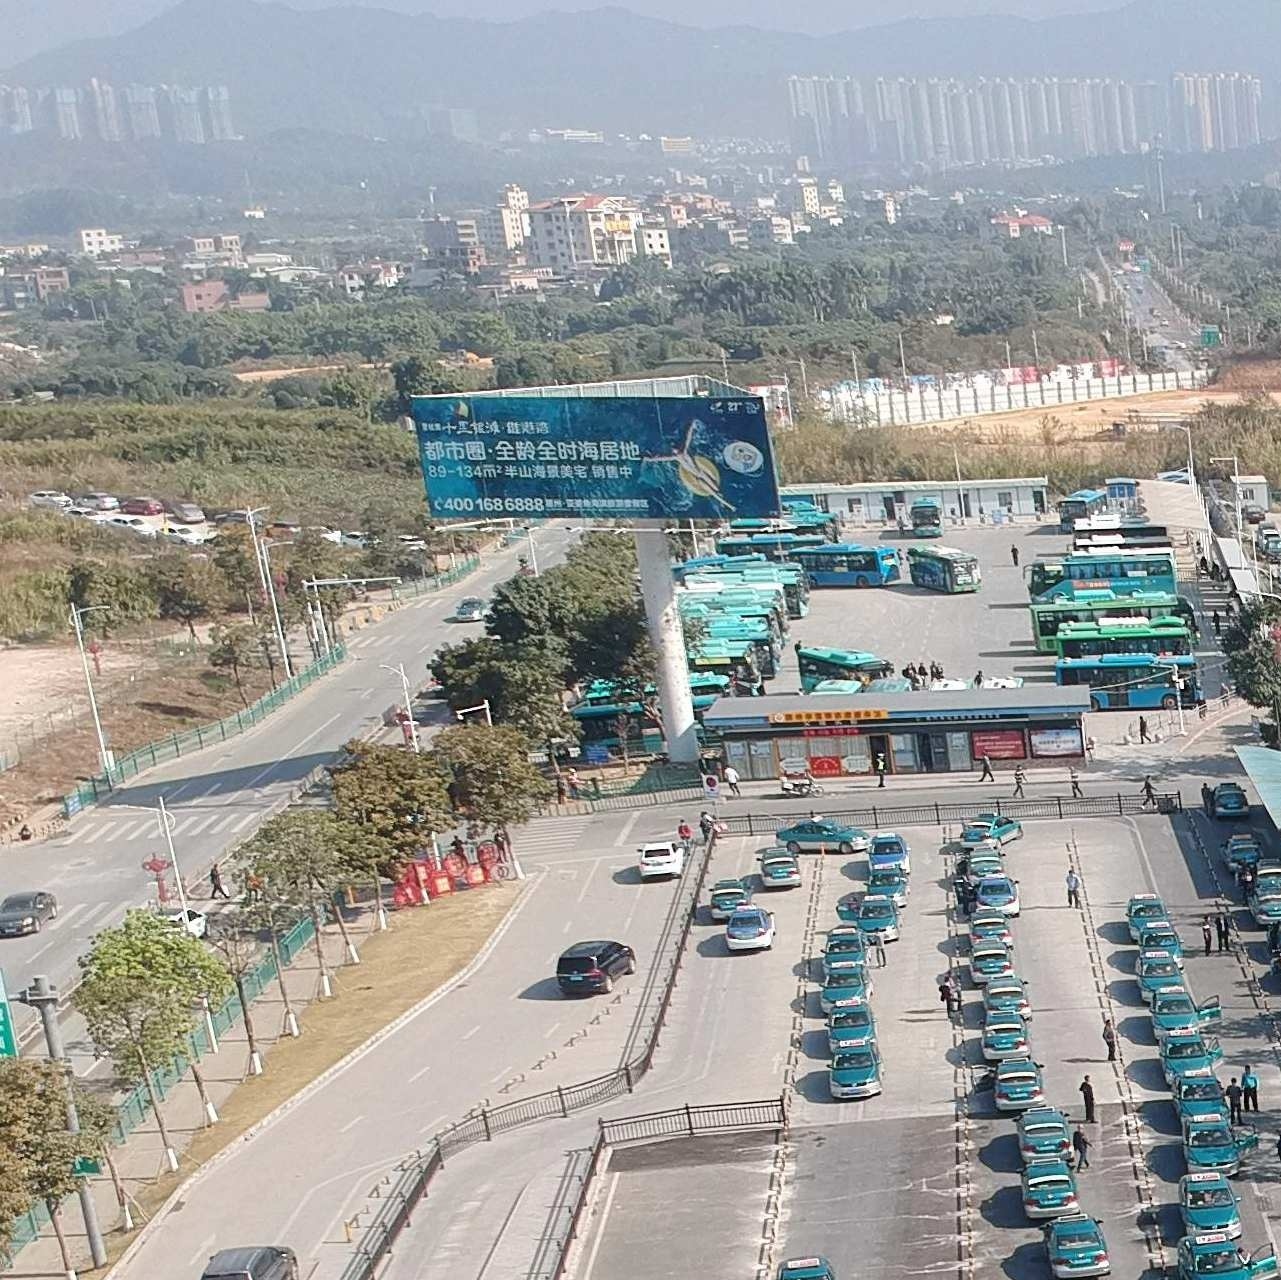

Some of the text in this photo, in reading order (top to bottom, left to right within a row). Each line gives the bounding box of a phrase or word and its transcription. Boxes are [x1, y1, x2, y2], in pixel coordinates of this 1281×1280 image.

[423, 441, 641, 461] 都市圈·全龄全时海居地
[444, 498, 473, 511] 400
[477, 498, 503, 511] 168
[504, 498, 545, 511] 6888
